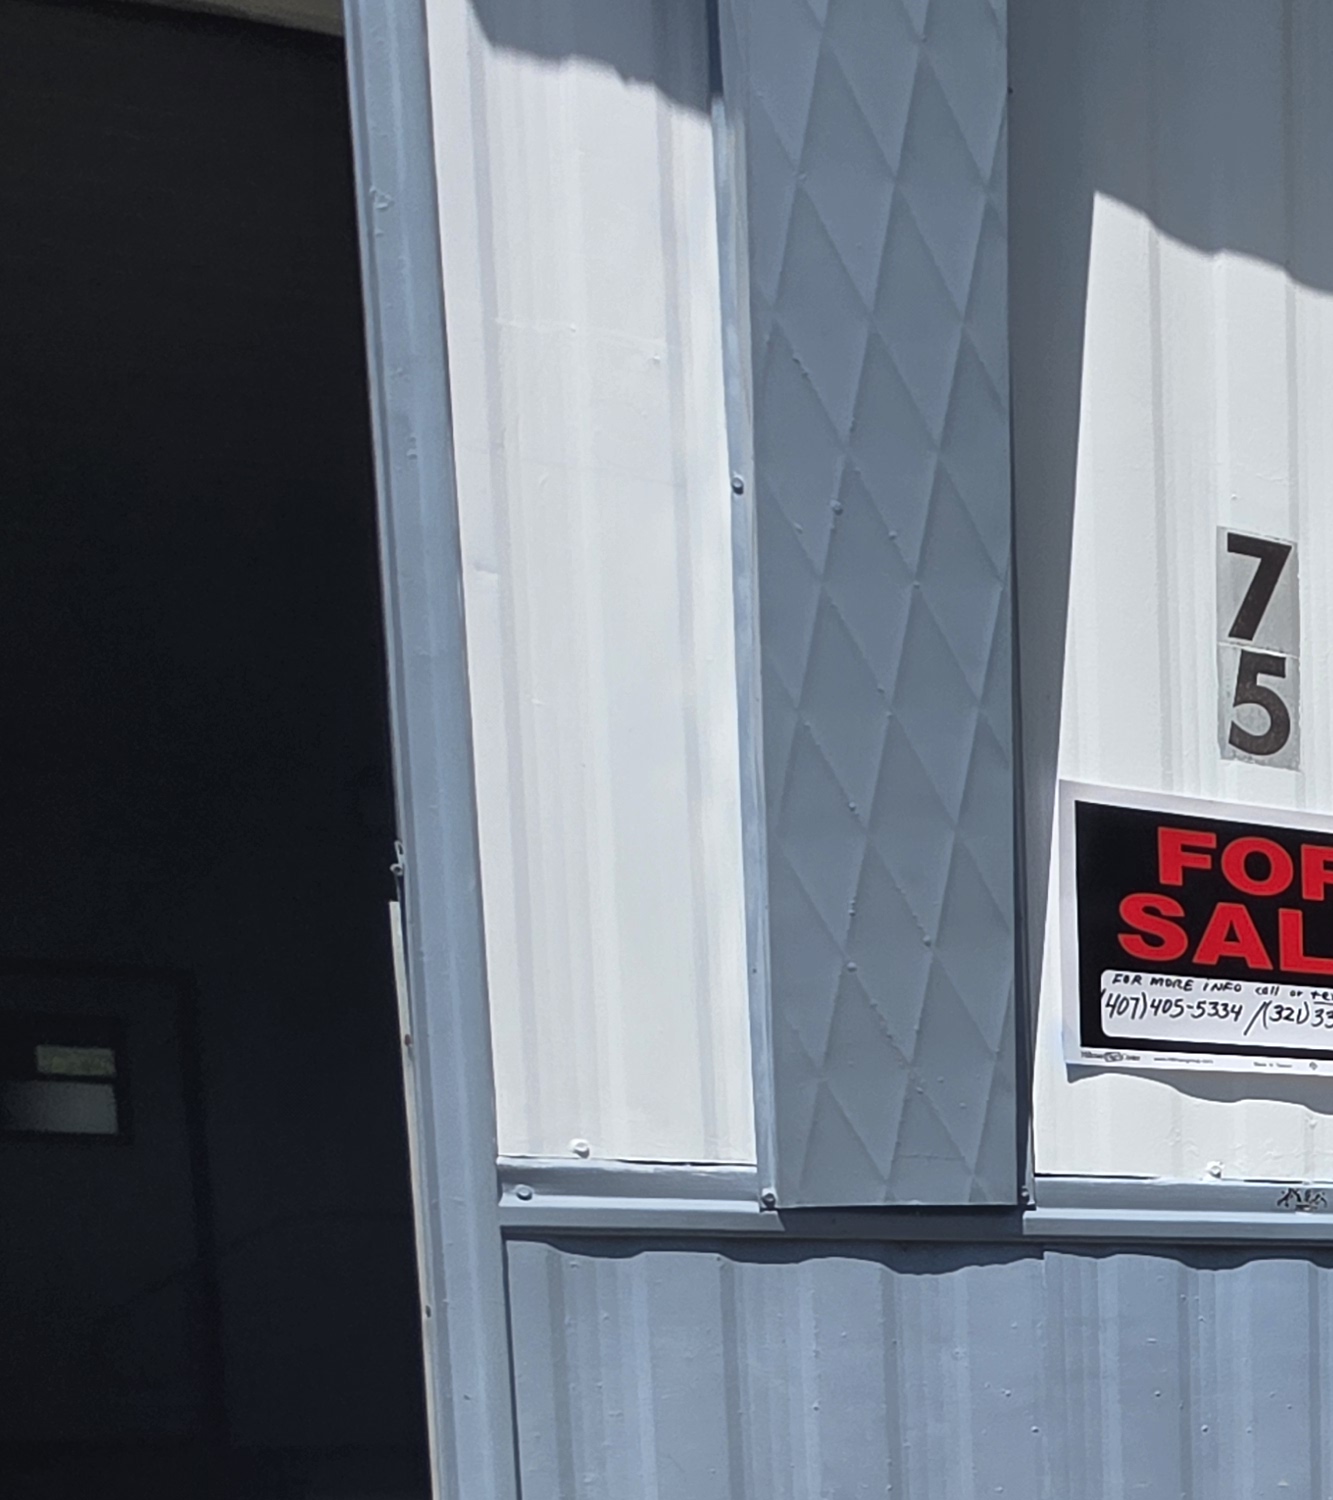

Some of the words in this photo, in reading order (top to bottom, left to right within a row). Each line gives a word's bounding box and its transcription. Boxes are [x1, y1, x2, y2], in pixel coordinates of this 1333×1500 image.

[1112, 973, 1143, 986] FOR
[1150, 977, 1194, 991] MORE
[1255, 986, 1279, 997] call
[1290, 990, 1303, 998] or
